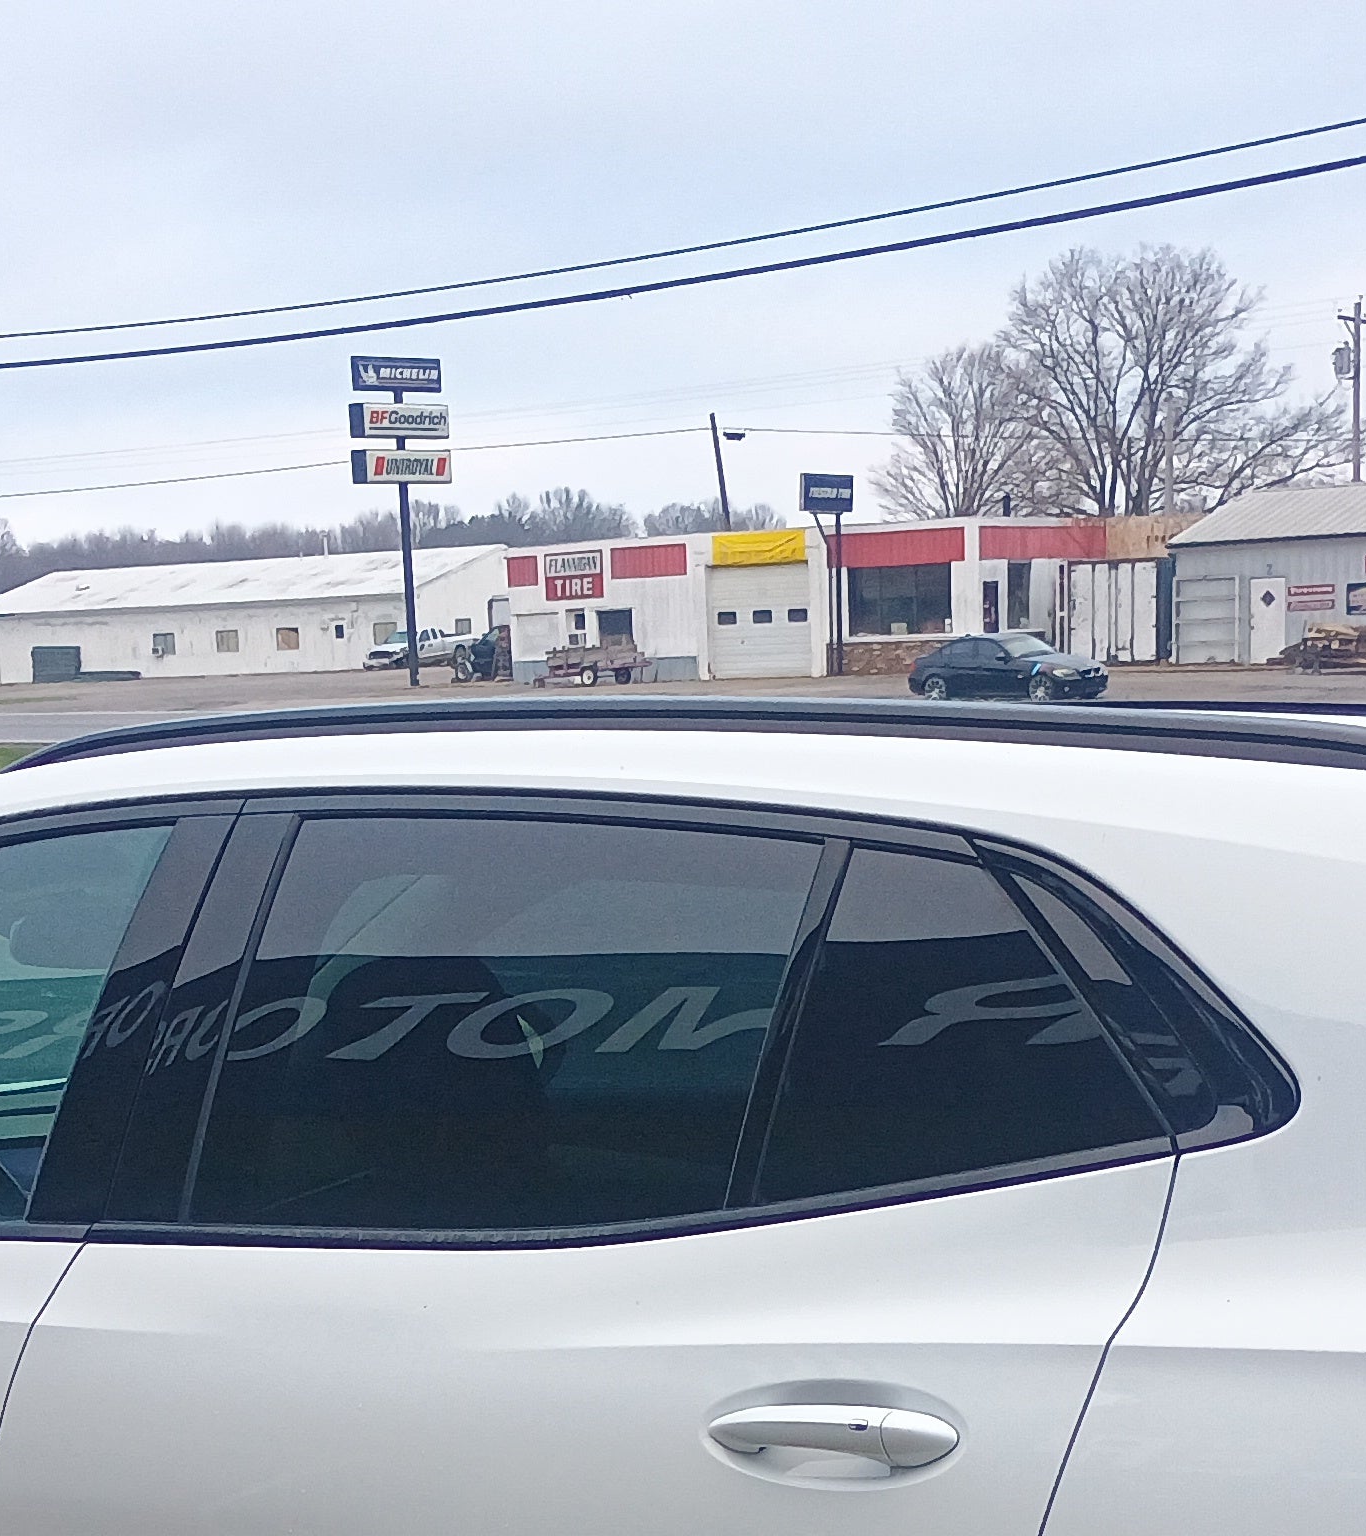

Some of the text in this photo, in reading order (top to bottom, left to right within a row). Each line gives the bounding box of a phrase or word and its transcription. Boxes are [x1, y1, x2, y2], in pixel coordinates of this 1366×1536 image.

[379, 367, 439, 381] MICHELIN
[369, 410, 447, 427] BFGoodrich
[385, 457, 435, 476] UNIROYAL
[554, 576, 593, 597] TIRE
